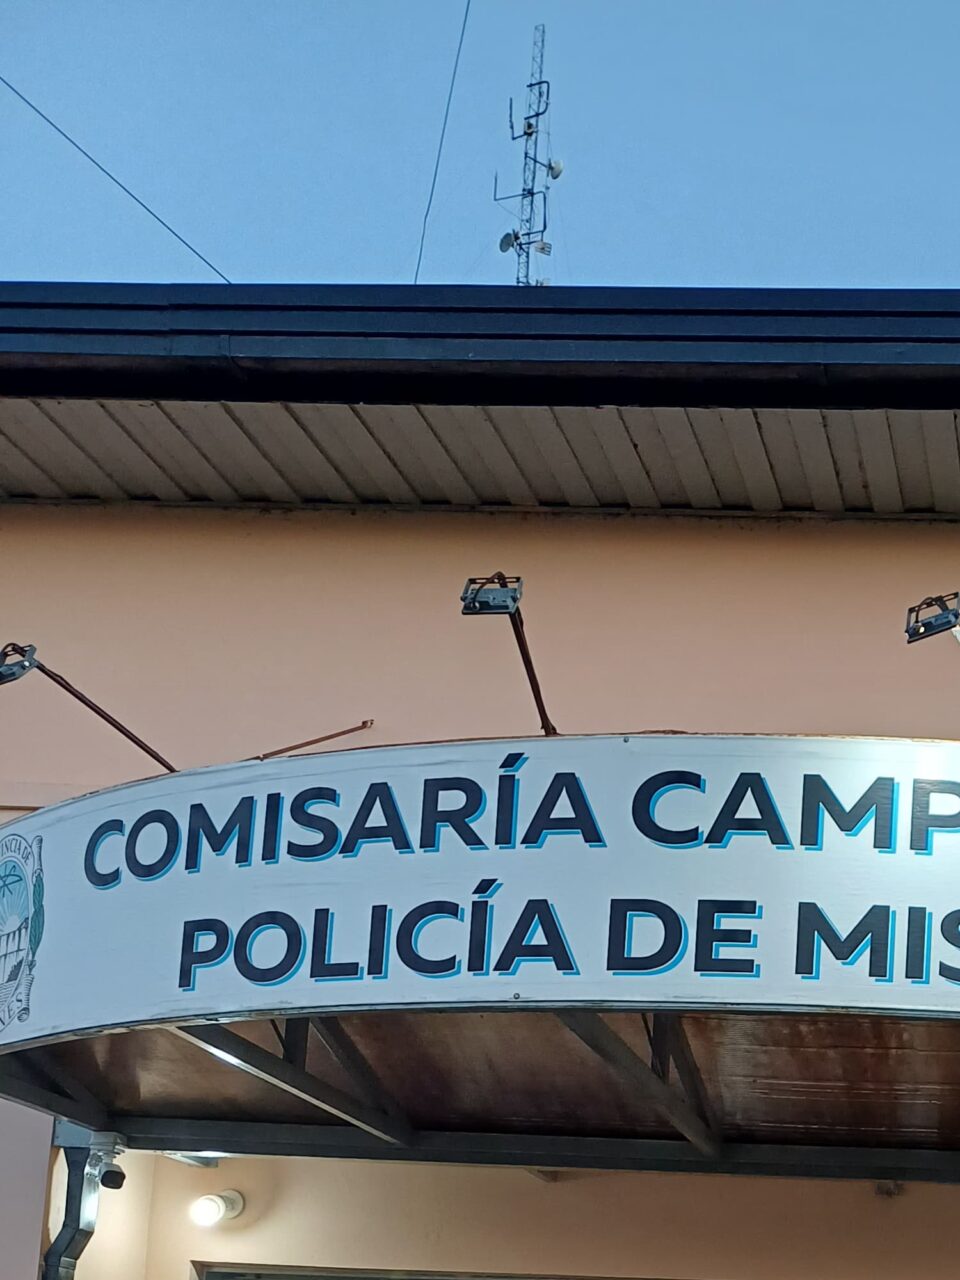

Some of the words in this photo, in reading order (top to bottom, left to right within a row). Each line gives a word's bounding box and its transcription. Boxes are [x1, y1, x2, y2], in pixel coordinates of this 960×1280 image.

[83, 752, 607, 891] COMISARÍA
[178, 877, 580, 991] POLICÍA
[605, 898, 763, 978] DE
